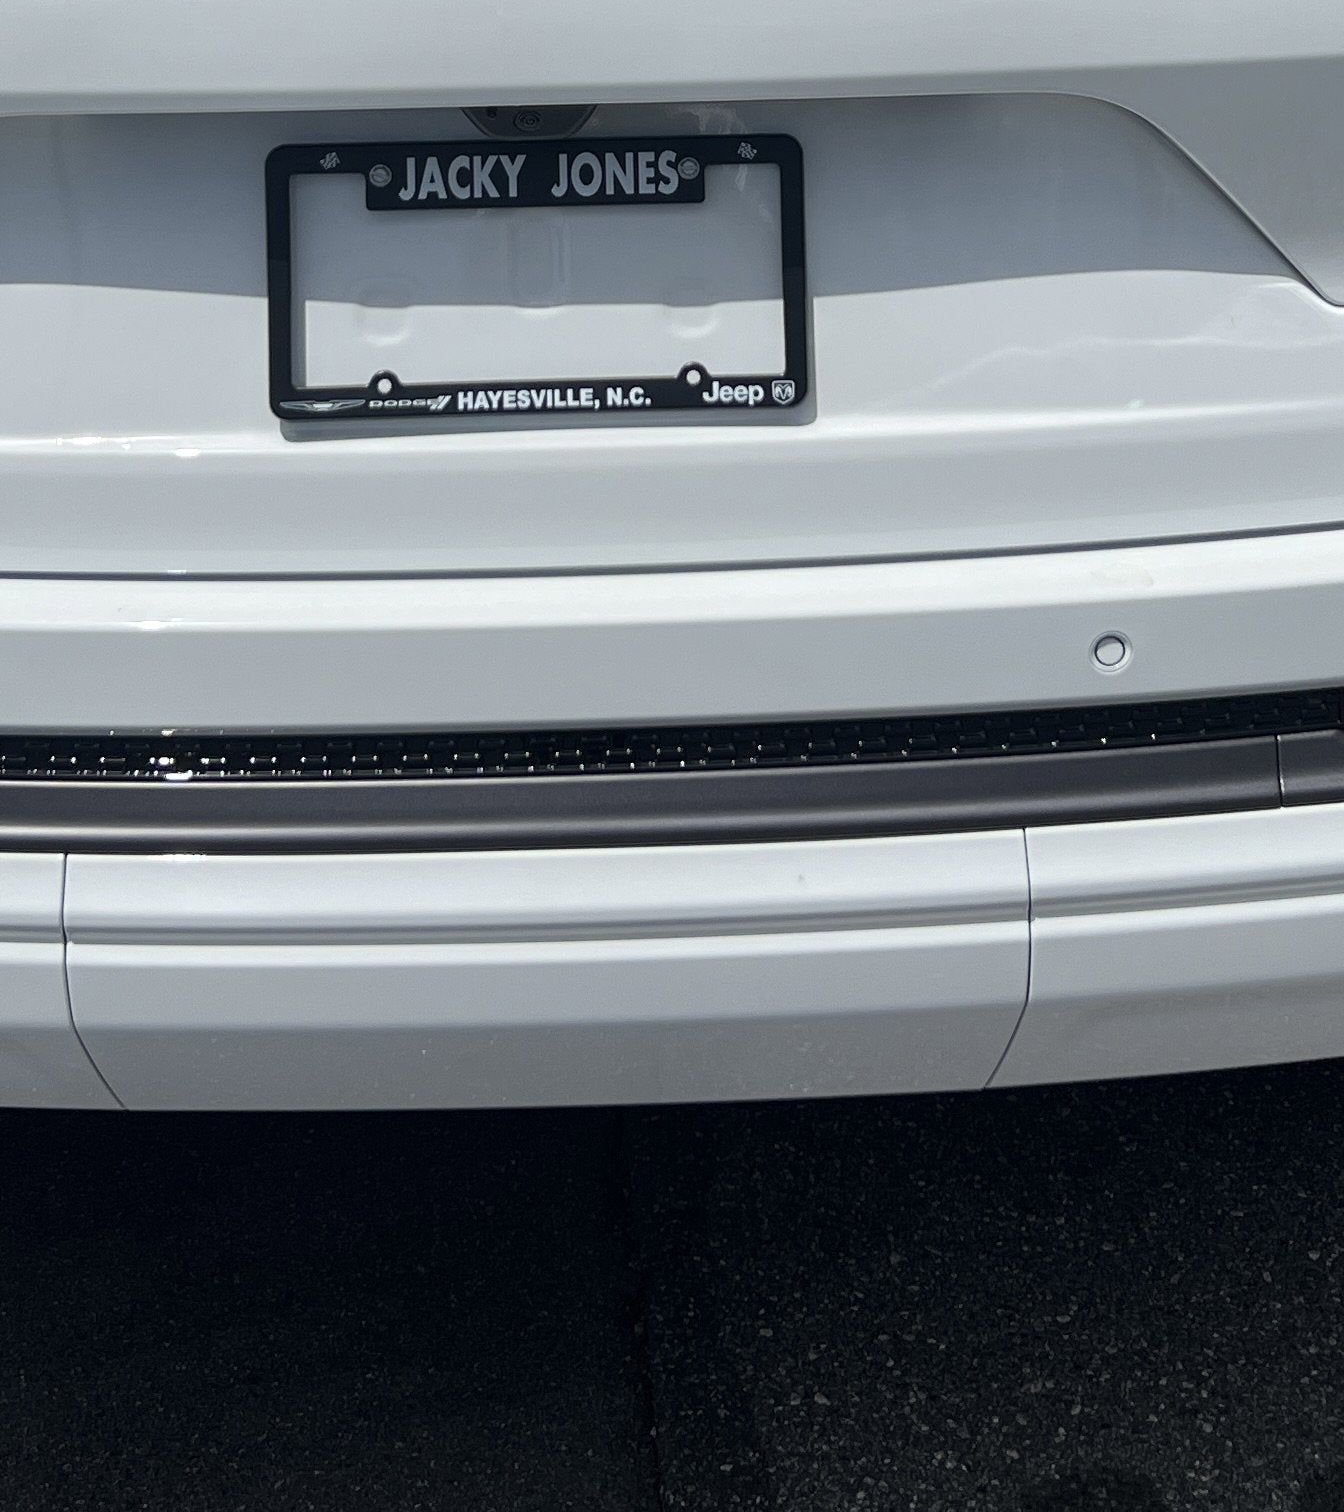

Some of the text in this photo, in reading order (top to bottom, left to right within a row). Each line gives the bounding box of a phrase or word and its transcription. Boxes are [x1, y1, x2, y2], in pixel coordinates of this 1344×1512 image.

[398, 149, 680, 202] JACKY JONES
[368, 380, 764, 411] DODGE HAYESVILLE, N.C. Jeep
